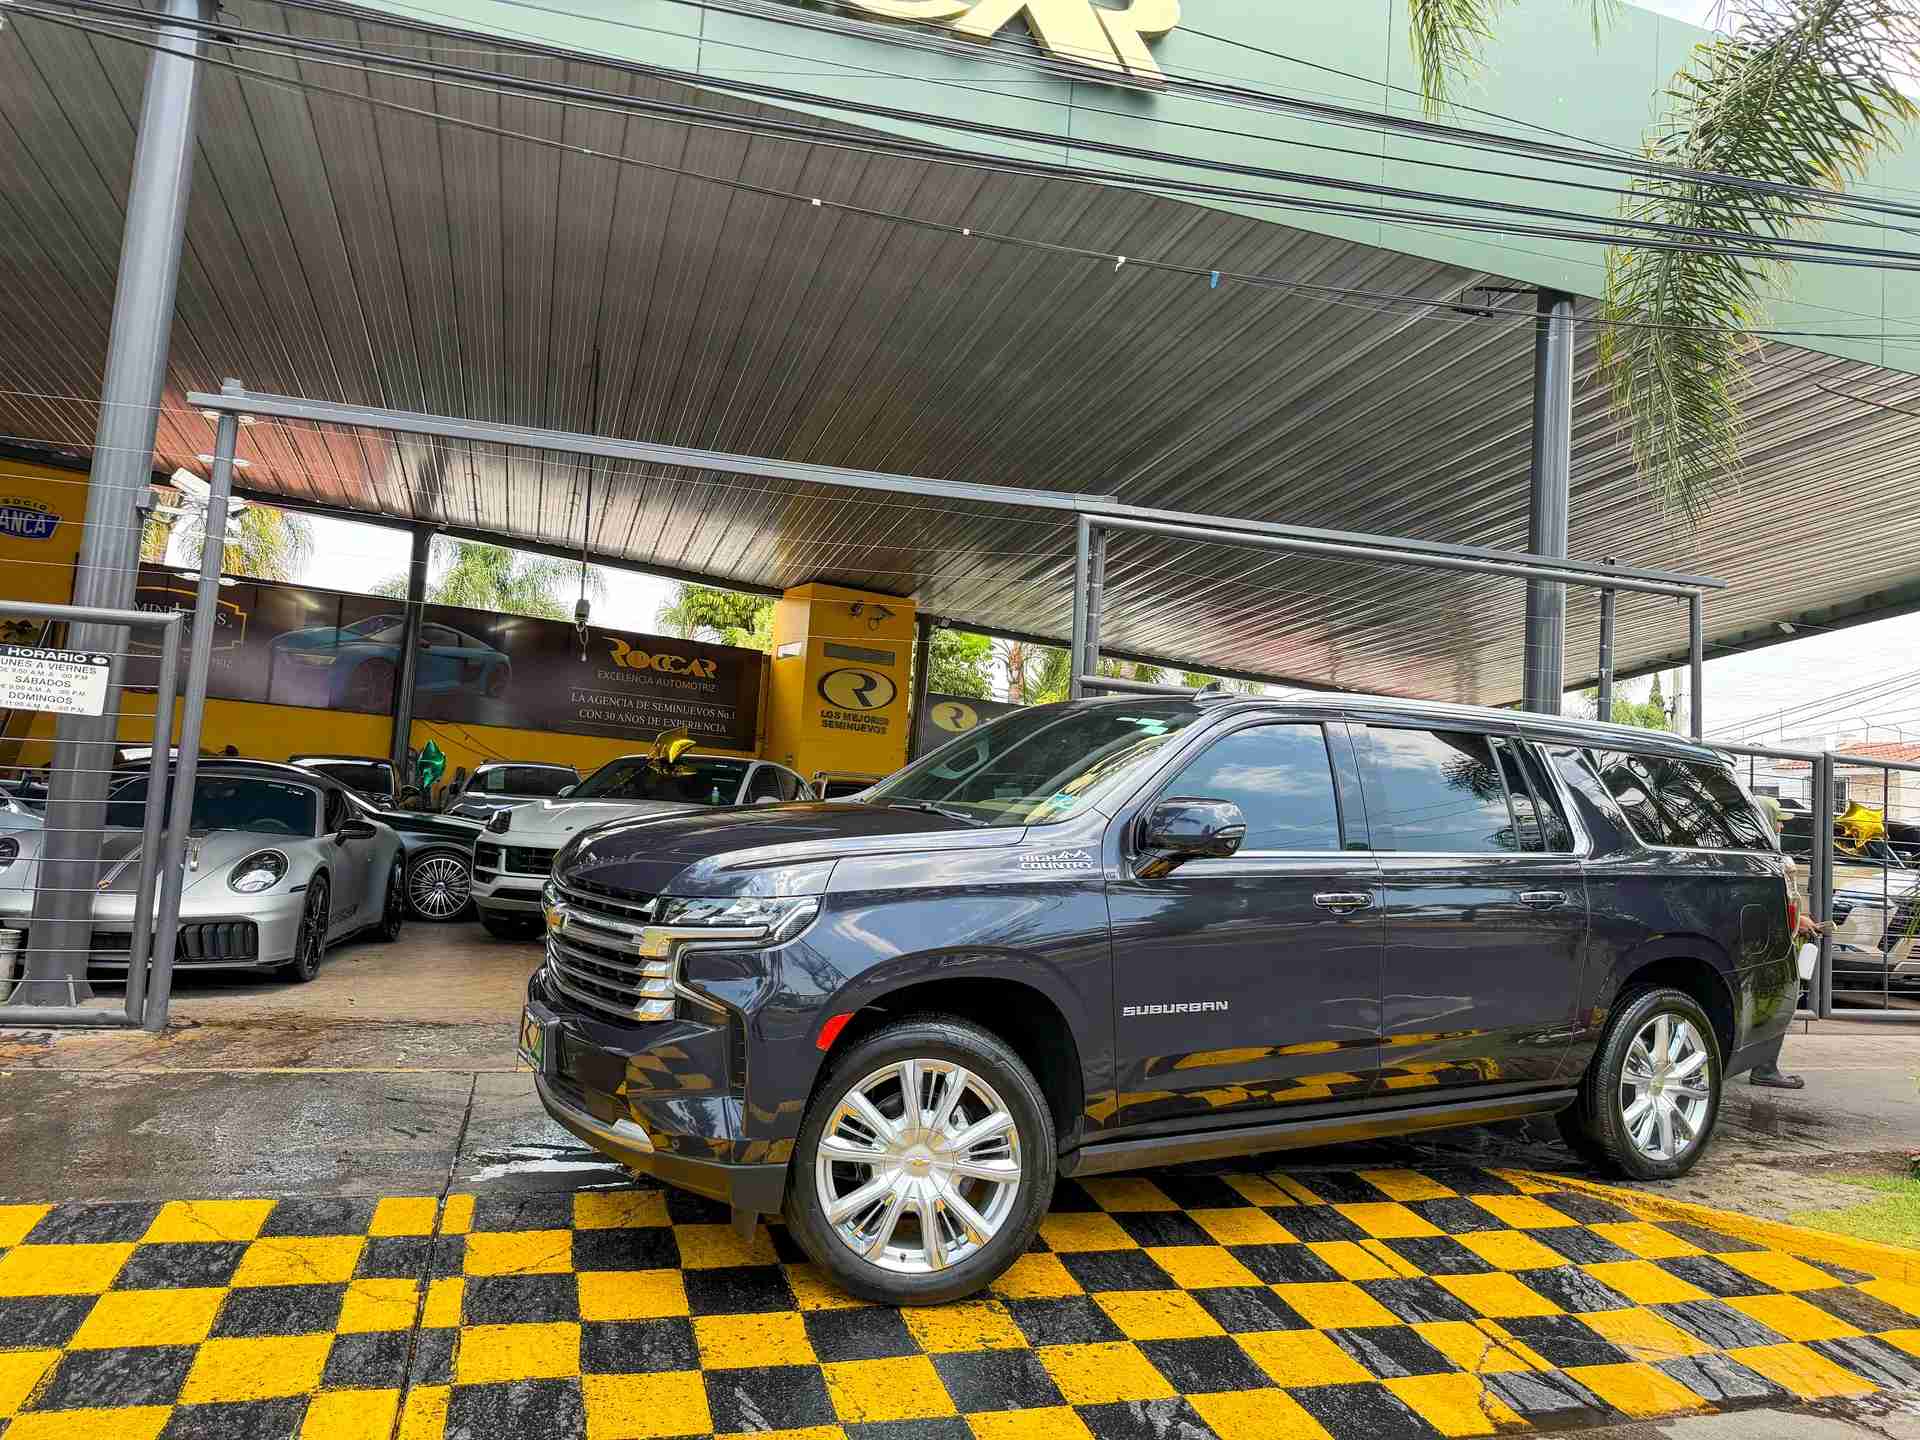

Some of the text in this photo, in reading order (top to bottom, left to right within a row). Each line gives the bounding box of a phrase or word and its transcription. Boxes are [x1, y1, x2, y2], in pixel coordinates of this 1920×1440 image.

[8, 647, 87, 663] HORARIO
[602, 637, 717, 678] ROCCAR
[0, 658, 31, 668] UNES
[48, 663, 97, 674] VIERNES
[597, 670, 653, 685] EXCELENCIA
[9, 691, 73, 704] DOMINGOS
[571, 691, 585, 703] LA
[588, 695, 634, 709] AGENCIA
[637, 699, 650, 710] DE
[651, 701, 715, 719] SEMINUEVOS
[579, 709, 727, 733] CON 30 AÑOS DE EXPERIENCIA
[821, 710, 841, 720] LOS
[822, 719, 887, 734] SEMINUEVOS
[1019, 854, 1056, 863] HIGH
[1020, 861, 1094, 871] COUNTRY
[1122, 1000, 1228, 1016] SUBURBAN
